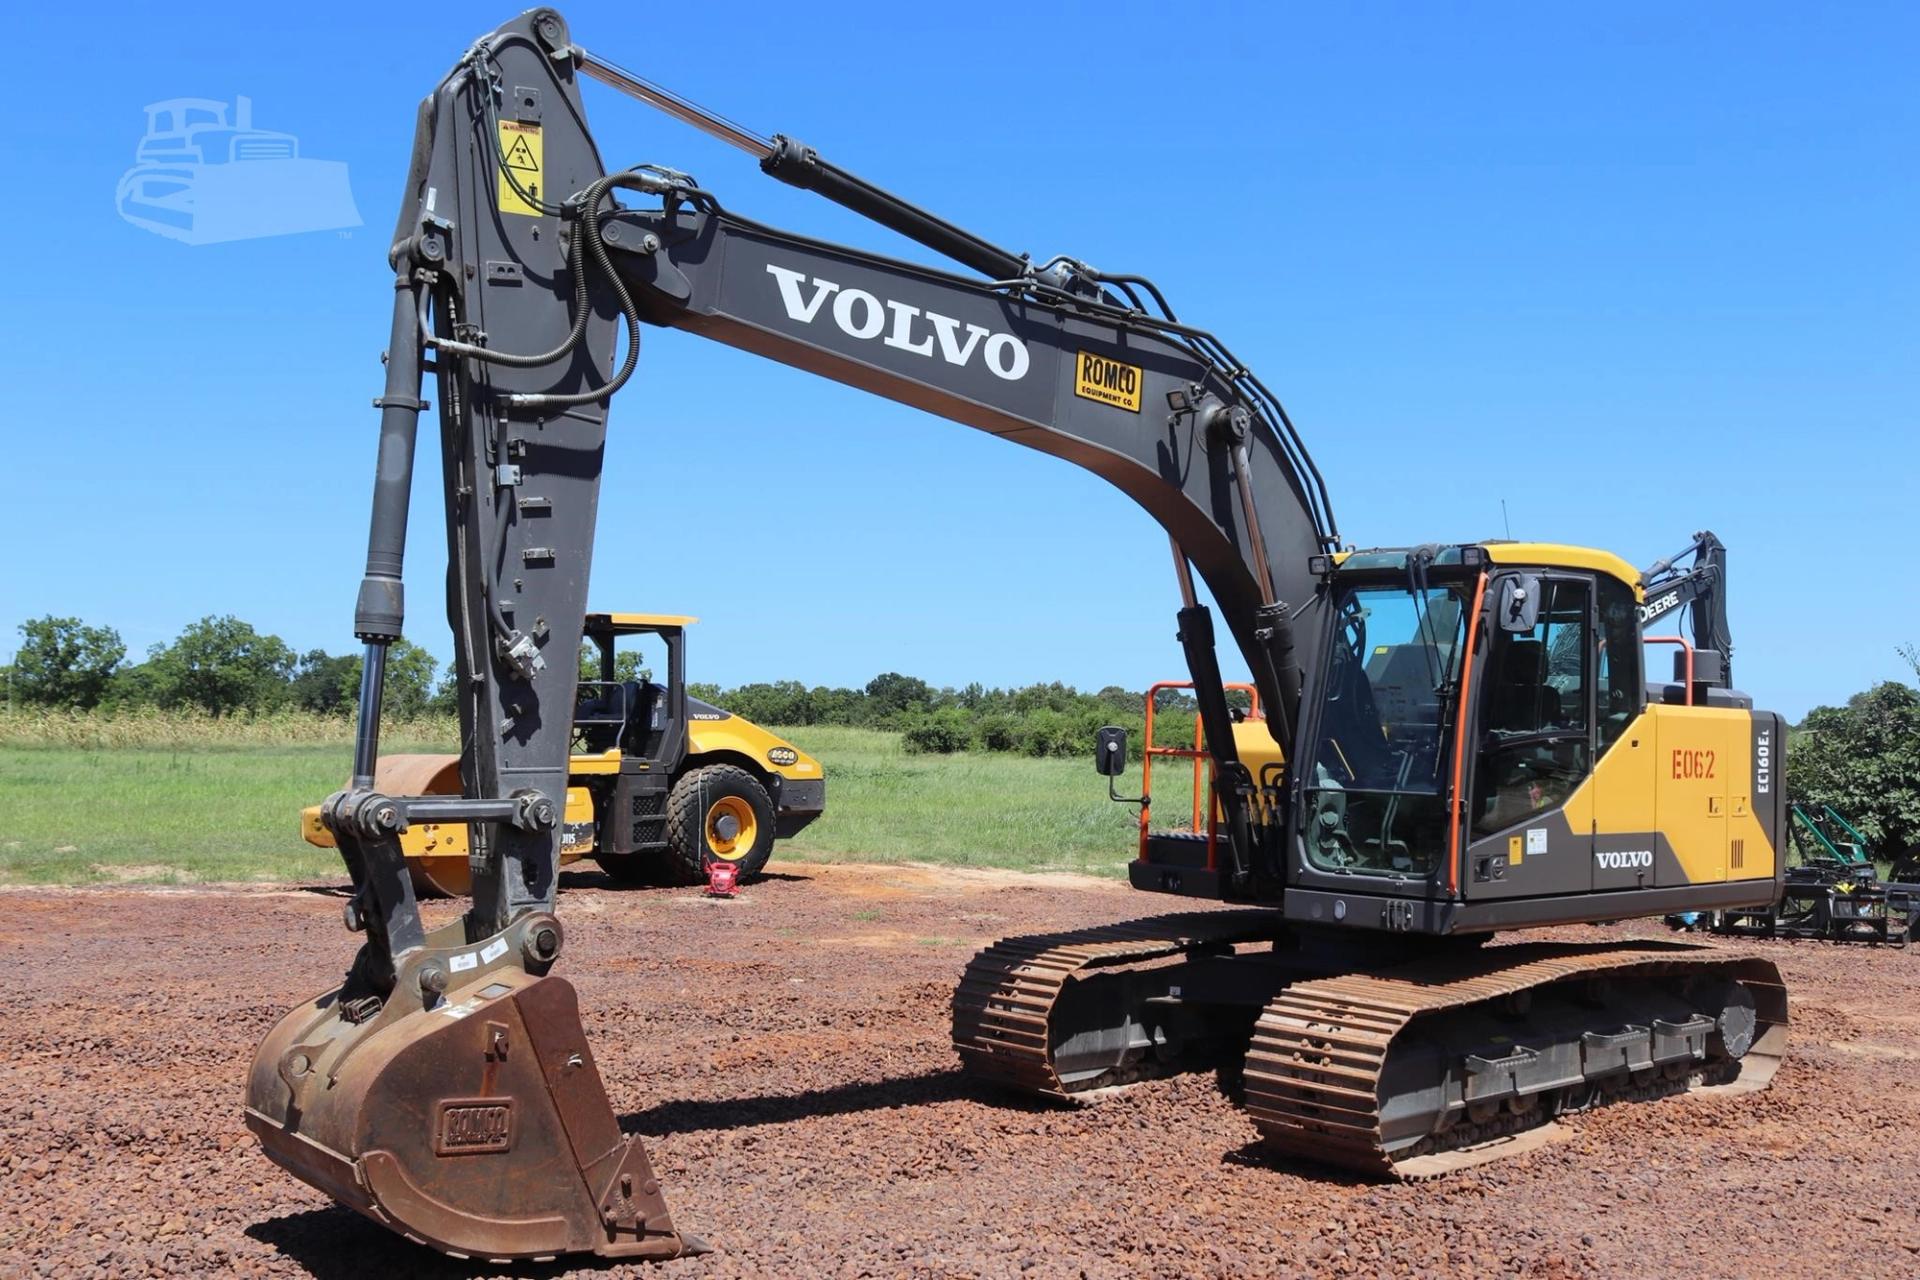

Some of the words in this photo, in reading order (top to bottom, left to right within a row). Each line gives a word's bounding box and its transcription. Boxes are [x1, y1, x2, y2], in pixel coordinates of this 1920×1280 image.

[766, 263, 1030, 381] VOLVO
[1082, 354, 1136, 395] ROMCO
[1081, 386, 1121, 403] EQUIPMENT
[1123, 398, 1134, 407] CO.
[1638, 590, 1679, 623] DEERE
[1672, 749, 1715, 780] E062
[1595, 850, 1653, 869] VOLVO
